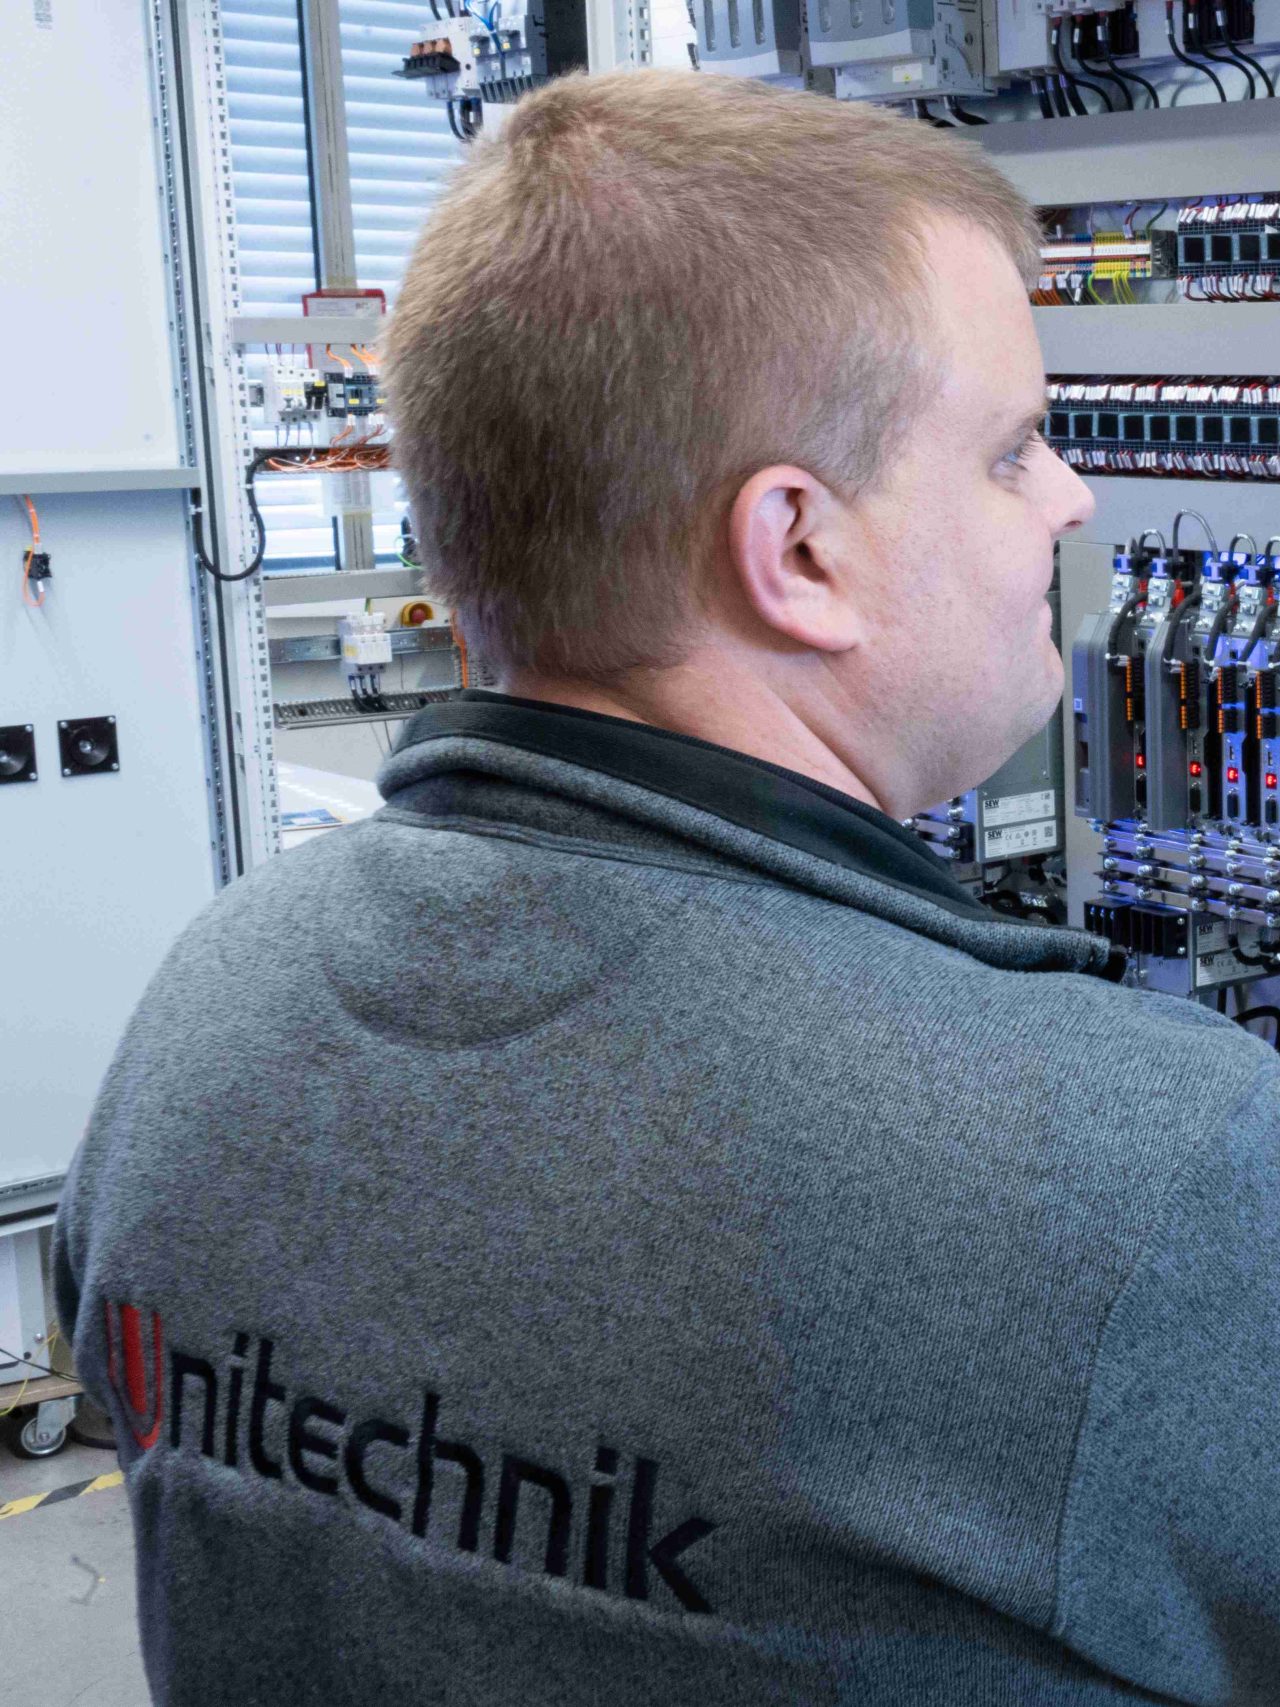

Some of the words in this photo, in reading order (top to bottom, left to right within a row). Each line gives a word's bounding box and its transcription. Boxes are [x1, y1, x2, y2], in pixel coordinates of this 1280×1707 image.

[985, 800, 1000, 808] SEW
[987, 830, 1002, 839] SEW
[106, 1300, 716, 1614] Unitechnik
